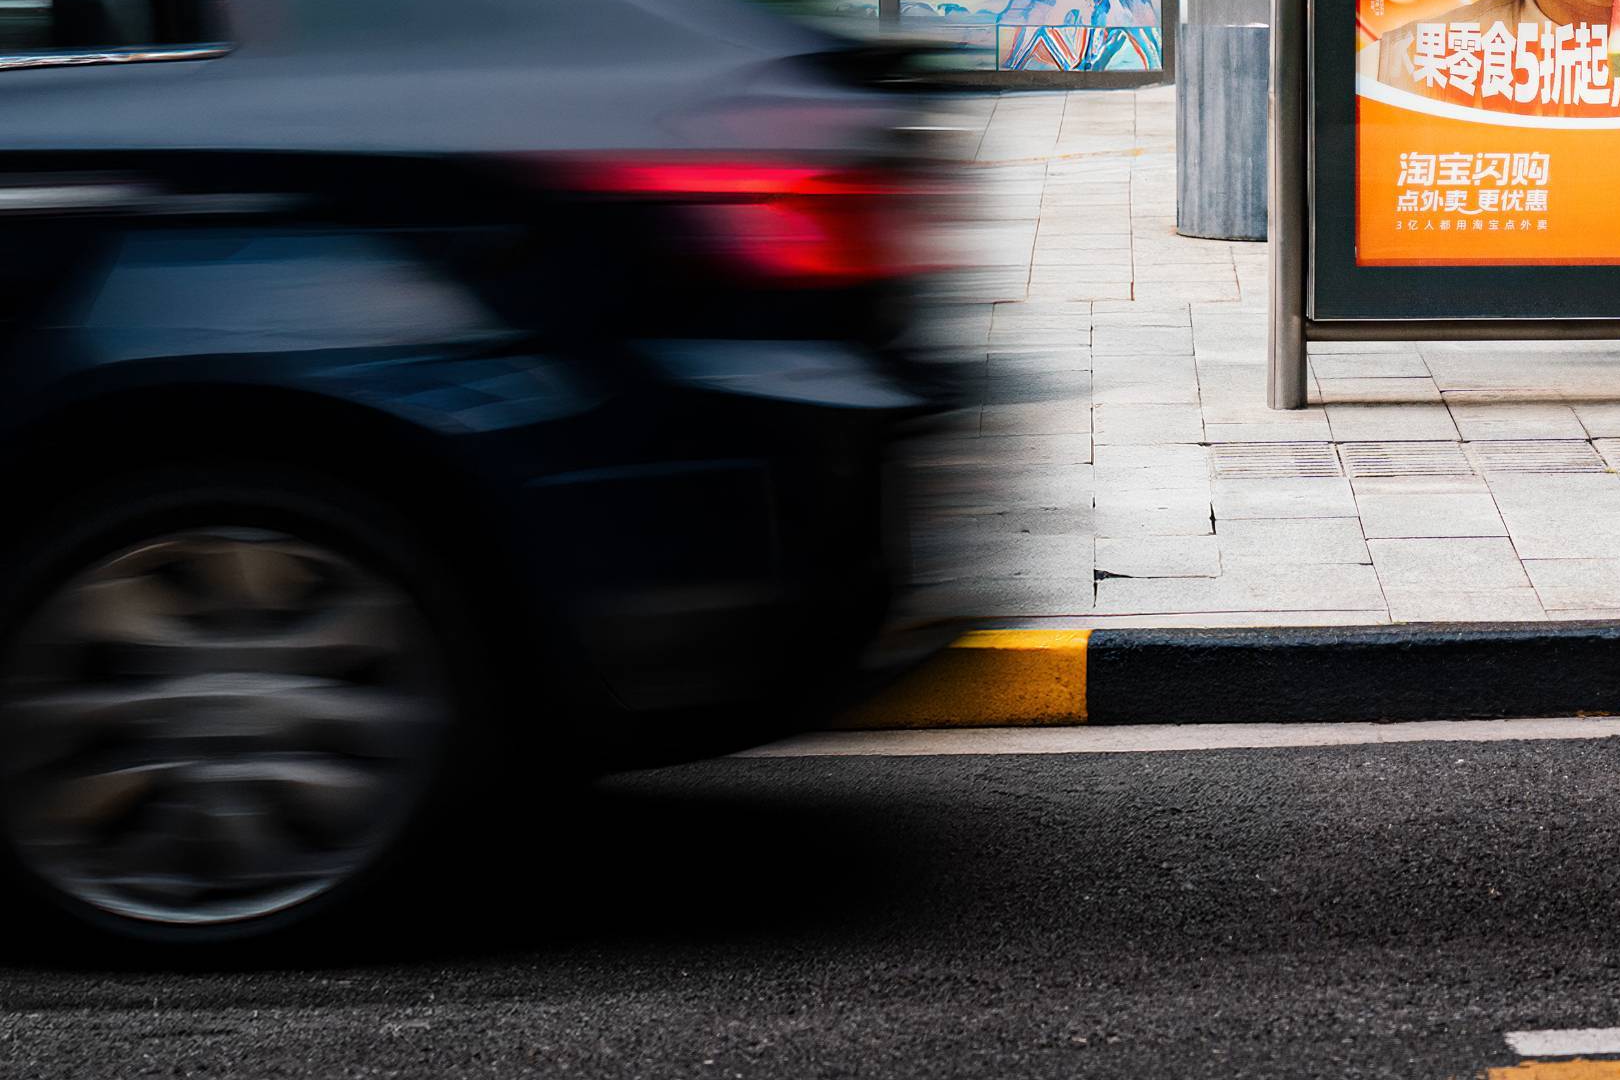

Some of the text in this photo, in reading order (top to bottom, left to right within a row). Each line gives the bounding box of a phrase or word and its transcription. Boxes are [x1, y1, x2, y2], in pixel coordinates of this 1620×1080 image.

[1397, 151, 1550, 186] 淘宝闪购
[1397, 190, 1549, 213] 点外卖 更优惠
[1396, 219, 1549, 231] 3亿人都用淘宝点外卖
